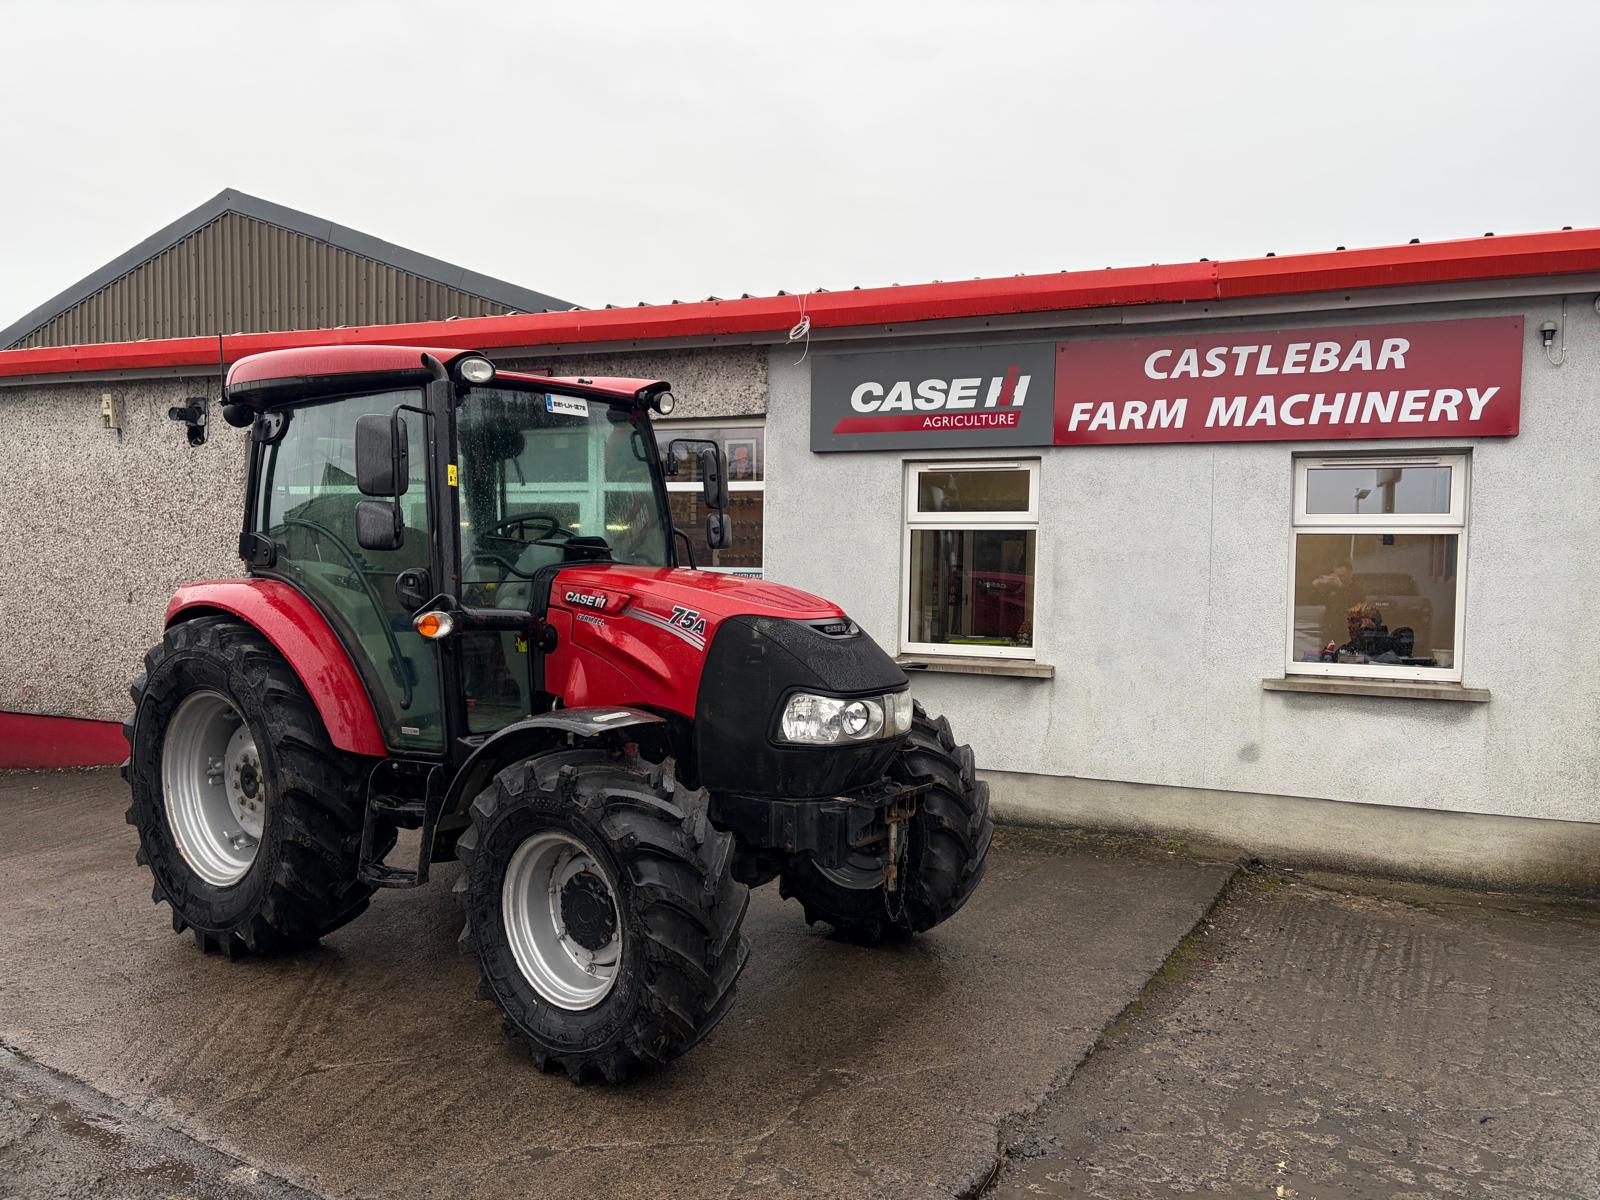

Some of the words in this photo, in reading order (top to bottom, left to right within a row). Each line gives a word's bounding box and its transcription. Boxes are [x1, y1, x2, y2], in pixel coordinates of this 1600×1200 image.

[1144, 337, 1410, 380] CASTLEBAR
[850, 377, 982, 413] CASE
[1067, 398, 1188, 432] FARM
[1204, 386, 1500, 428] MACHINERY
[923, 413, 1015, 428] AGRICULTURE
[565, 591, 595, 606] CASE
[669, 605, 706, 635] 75A
